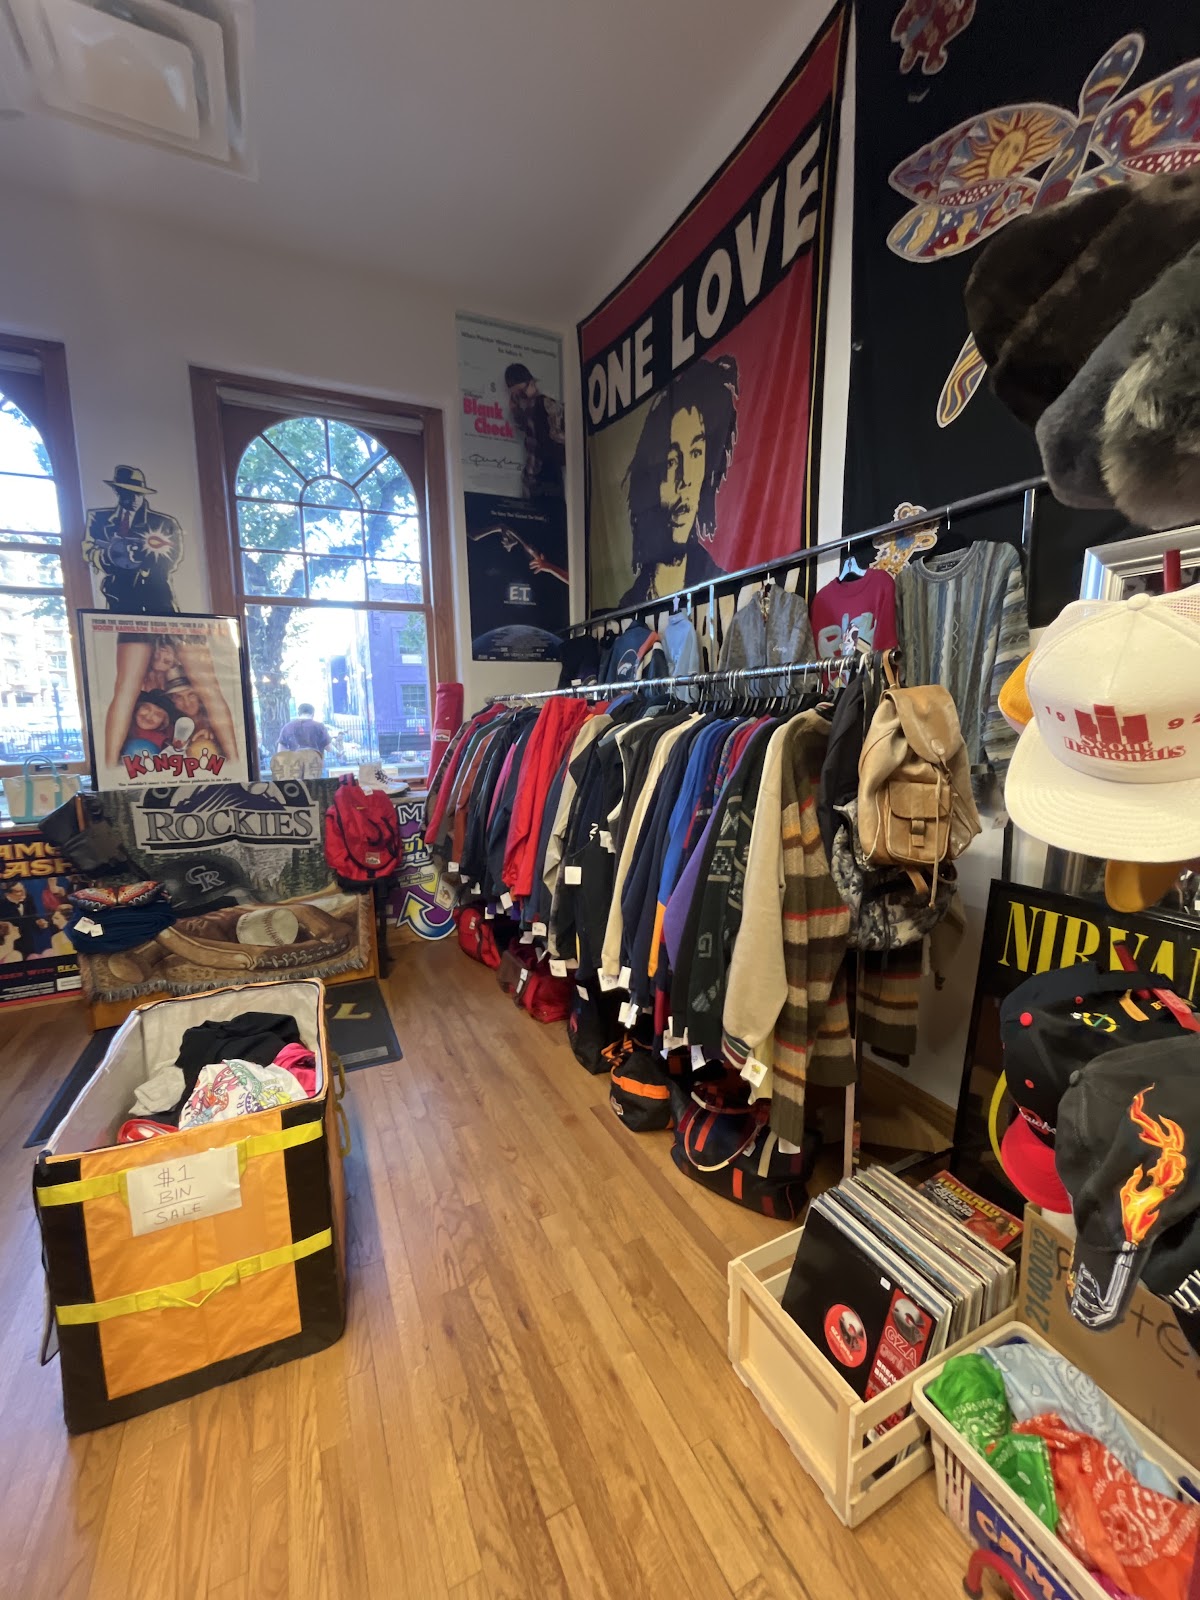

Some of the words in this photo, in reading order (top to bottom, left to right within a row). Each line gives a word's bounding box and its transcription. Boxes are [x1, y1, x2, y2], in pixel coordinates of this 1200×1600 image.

[587, 316, 653, 425] ONE
[671, 122, 822, 371] LOVE
[463, 395, 504, 419] Blank
[474, 417, 514, 438] Check
[509, 586, 531, 601] E.T.
[142, 808, 313, 841] ROCKIES
[57, 964, 79, 973] REA
[153, 1164, 195, 1188] $1
[159, 1185, 192, 1205] BIN
[154, 1202, 201, 1225] SALE
[885, 1325, 918, 1367] GZA
[975, 1510, 1062, 1600] CAM
